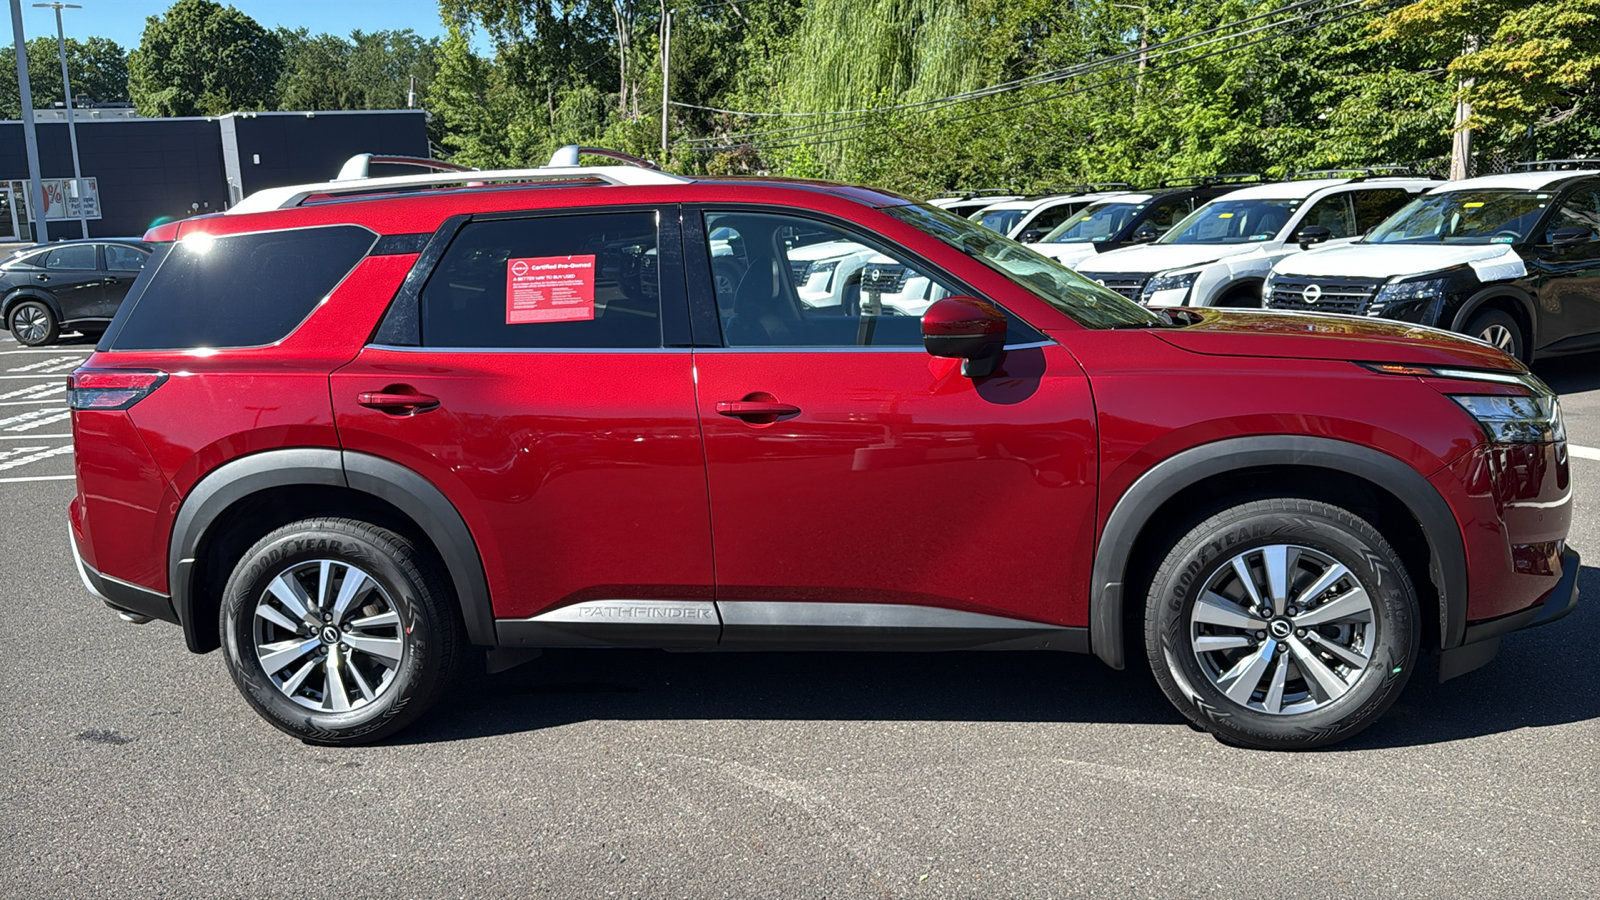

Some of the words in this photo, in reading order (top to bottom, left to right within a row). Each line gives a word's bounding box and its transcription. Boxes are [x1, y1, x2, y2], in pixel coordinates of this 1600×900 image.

[531, 263, 557, 271] Certified
[557, 262, 592, 270] Pre-Owned
[1168, 524, 1266, 611] GOODYEAR
[578, 606, 713, 619] PATHFINDER
